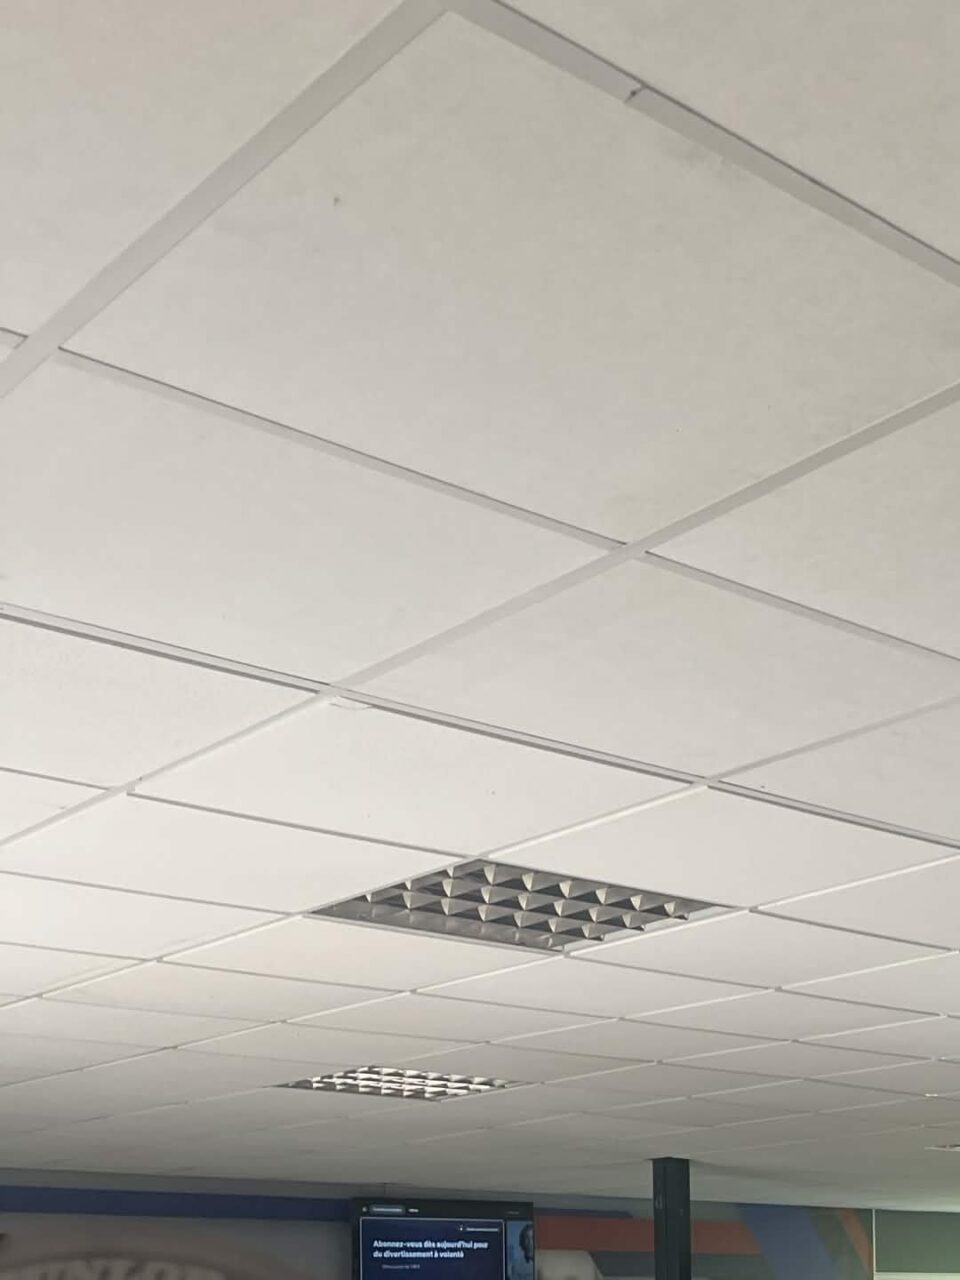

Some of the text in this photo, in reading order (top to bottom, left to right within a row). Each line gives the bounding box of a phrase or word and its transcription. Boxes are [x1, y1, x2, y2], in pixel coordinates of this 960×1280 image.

[373, 1240, 488, 1250] Abonnez-vous dès aujourd'hui pour
[384, 1250, 433, 1258] divertissement
[439, 1250, 464, 1258] volonté
